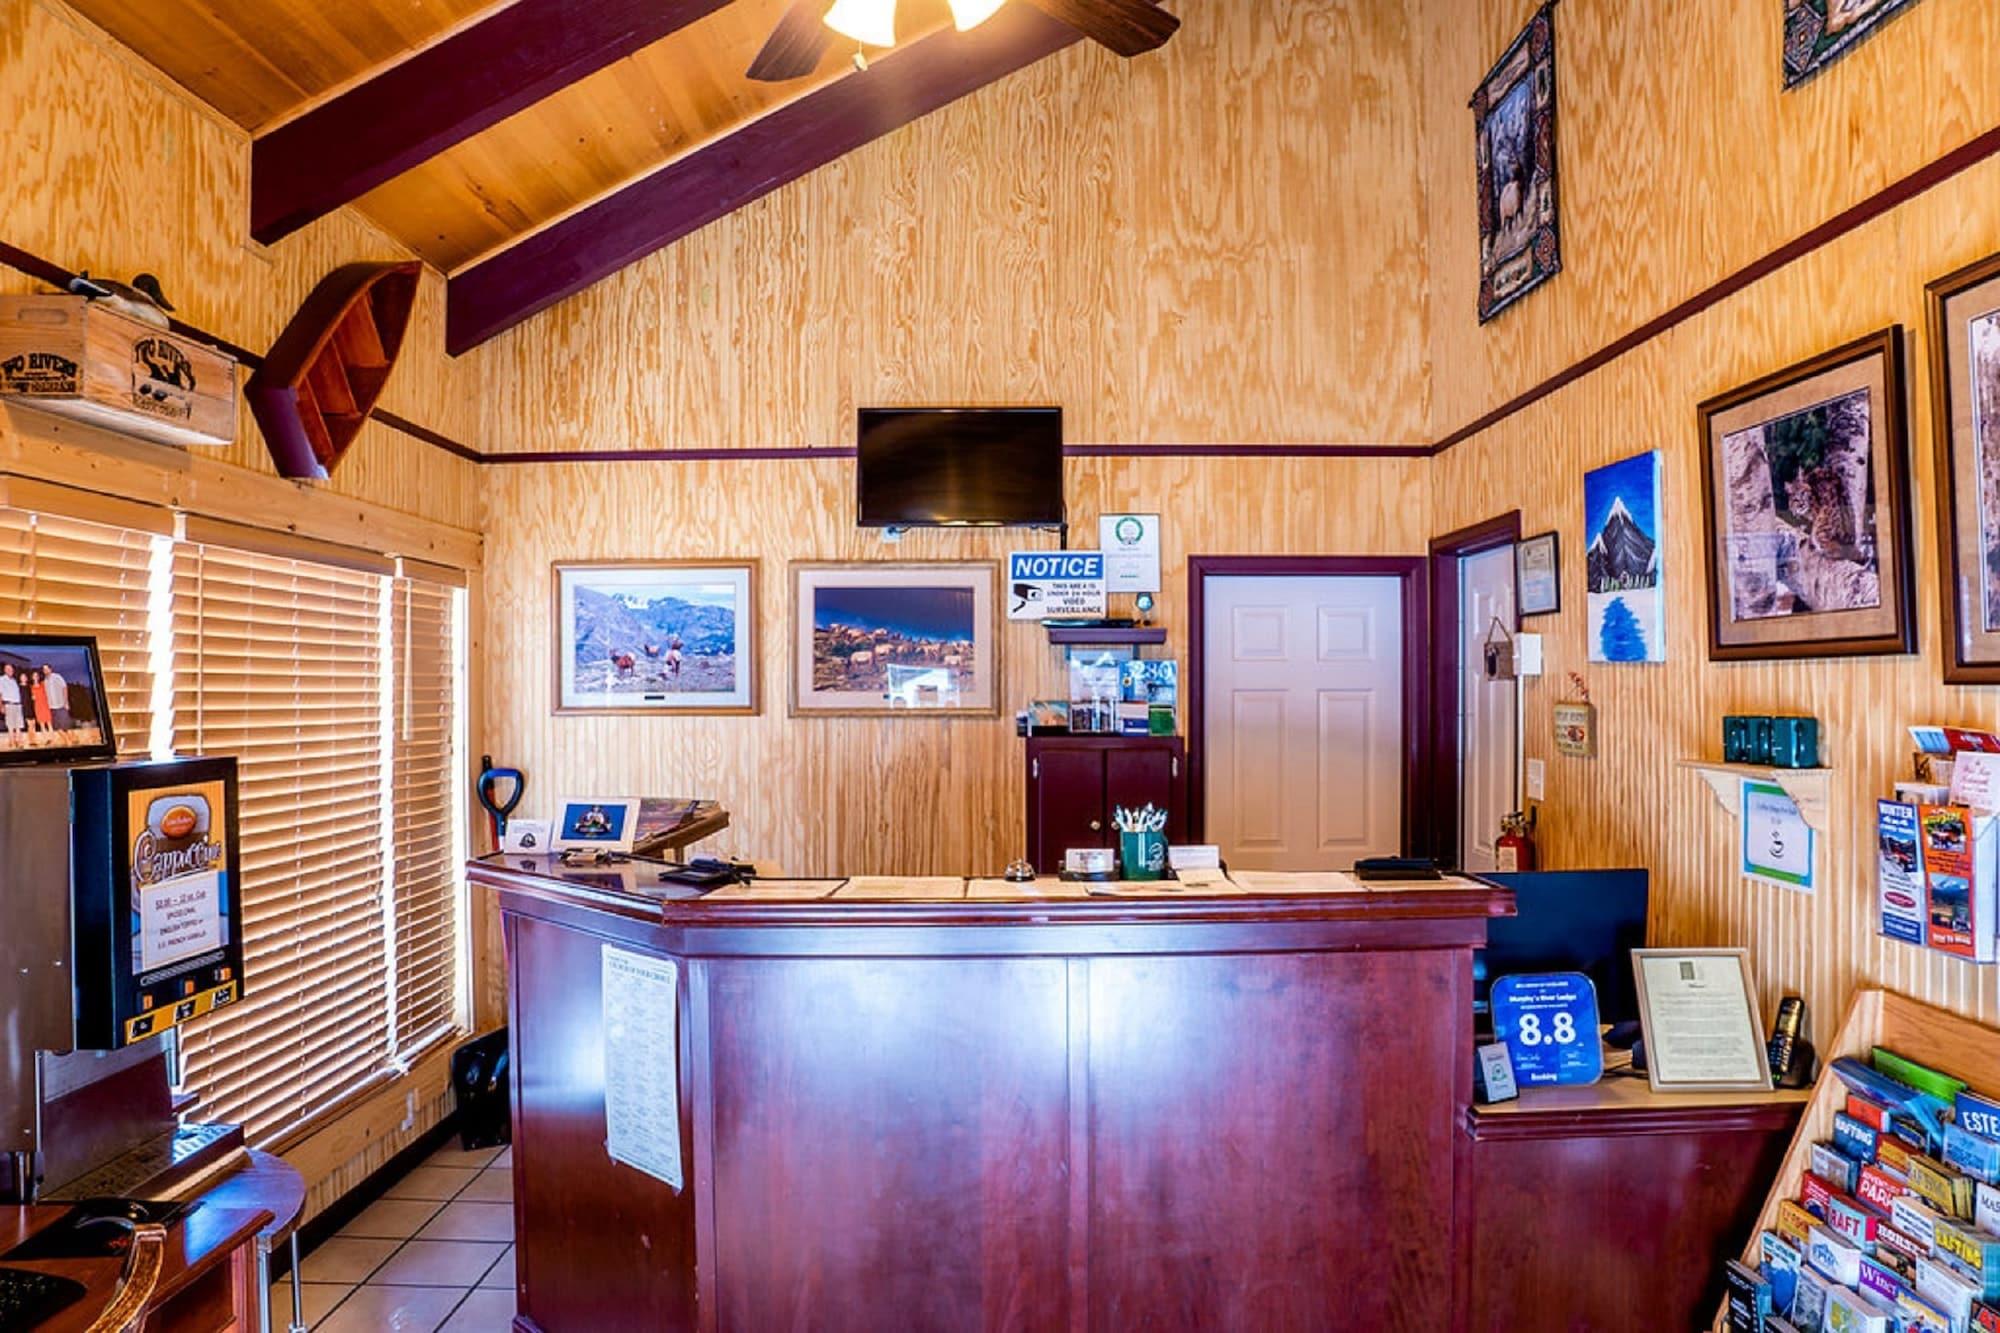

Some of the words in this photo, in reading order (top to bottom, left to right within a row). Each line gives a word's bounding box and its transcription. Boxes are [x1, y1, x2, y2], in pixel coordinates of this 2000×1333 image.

[29, 353, 77, 377] RIVERS
[1015, 557, 1099, 577] NOTICE
[1046, 606, 1101, 614] SURVEILLANCE
[1062, 598, 1086, 606] VIDEO
[1880, 804, 1913, 819] WINTER
[1541, 994, 1556, 1002] River
[1557, 993, 1577, 1003] Lodge
[1518, 1012, 1577, 1047] 8.8
[1830, 1208, 1861, 1238] RAFT
